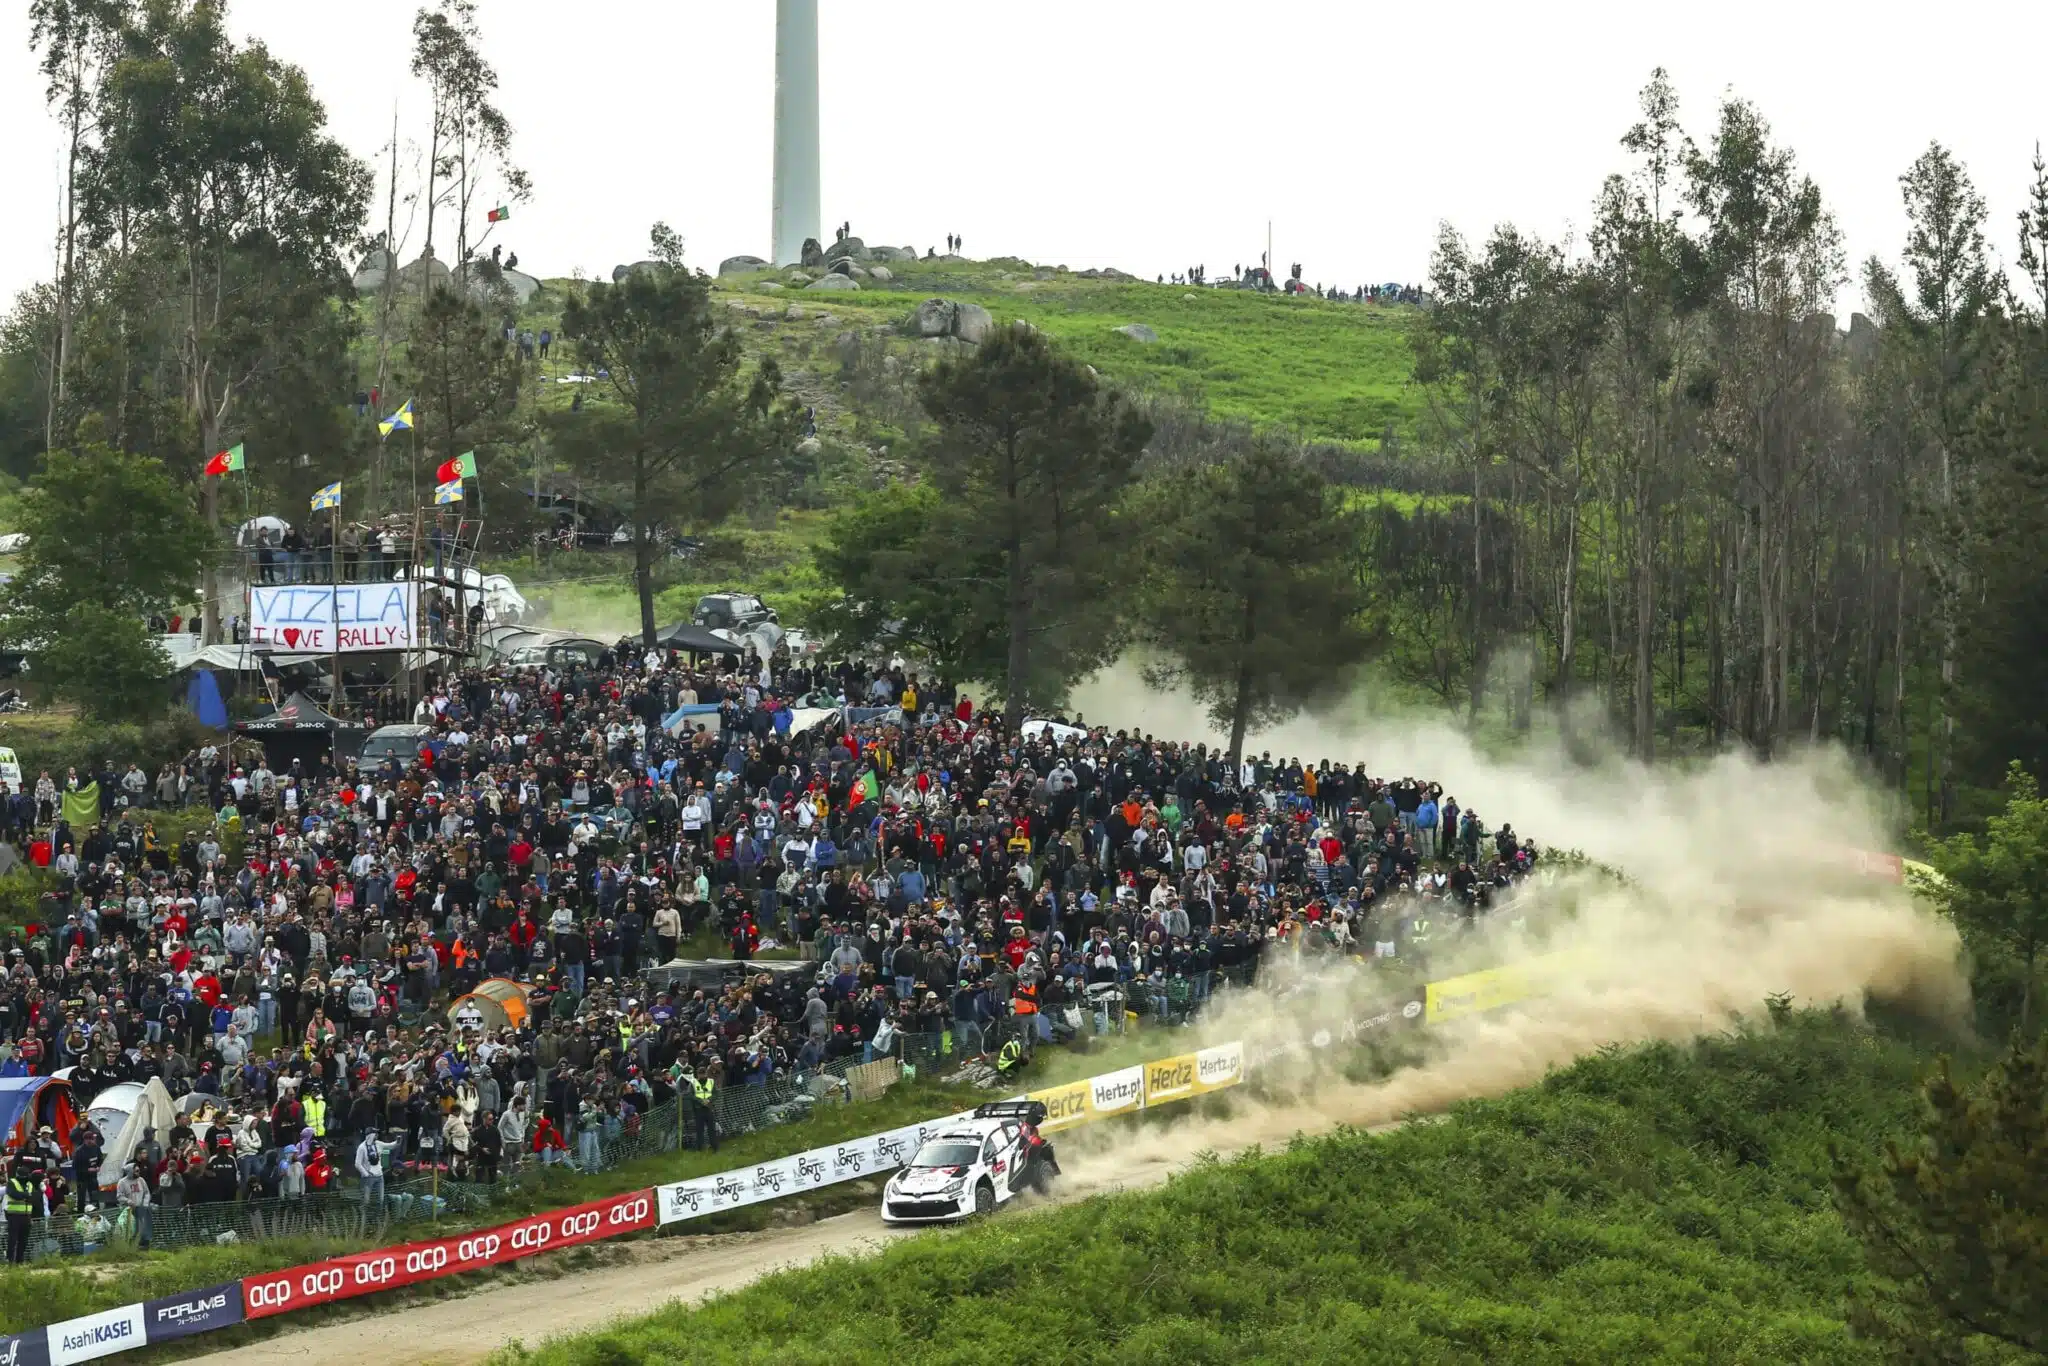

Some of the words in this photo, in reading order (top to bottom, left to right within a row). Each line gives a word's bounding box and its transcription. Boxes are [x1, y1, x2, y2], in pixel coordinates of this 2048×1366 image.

[255, 586, 408, 624] VIZELA
[253, 627, 267, 645] I
[338, 626, 397, 647] RALLY
[1150, 1063, 1192, 1091] Hertz
[1198, 1052, 1241, 1076] Hertz.pt
[1095, 1077, 1141, 1104] Hertz.pt
[561, 1210, 600, 1237] acp
[609, 1198, 648, 1225] acp
[458, 1234, 501, 1261] acp
[511, 1222, 551, 1249] acp
[354, 1257, 395, 1285] acp
[406, 1246, 447, 1273] acp
[249, 1279, 291, 1308] acp
[302, 1267, 344, 1295] acp
[62, 1319, 133, 1352] AsahiKASEI
[0, 1339, 21, 1366] olf
